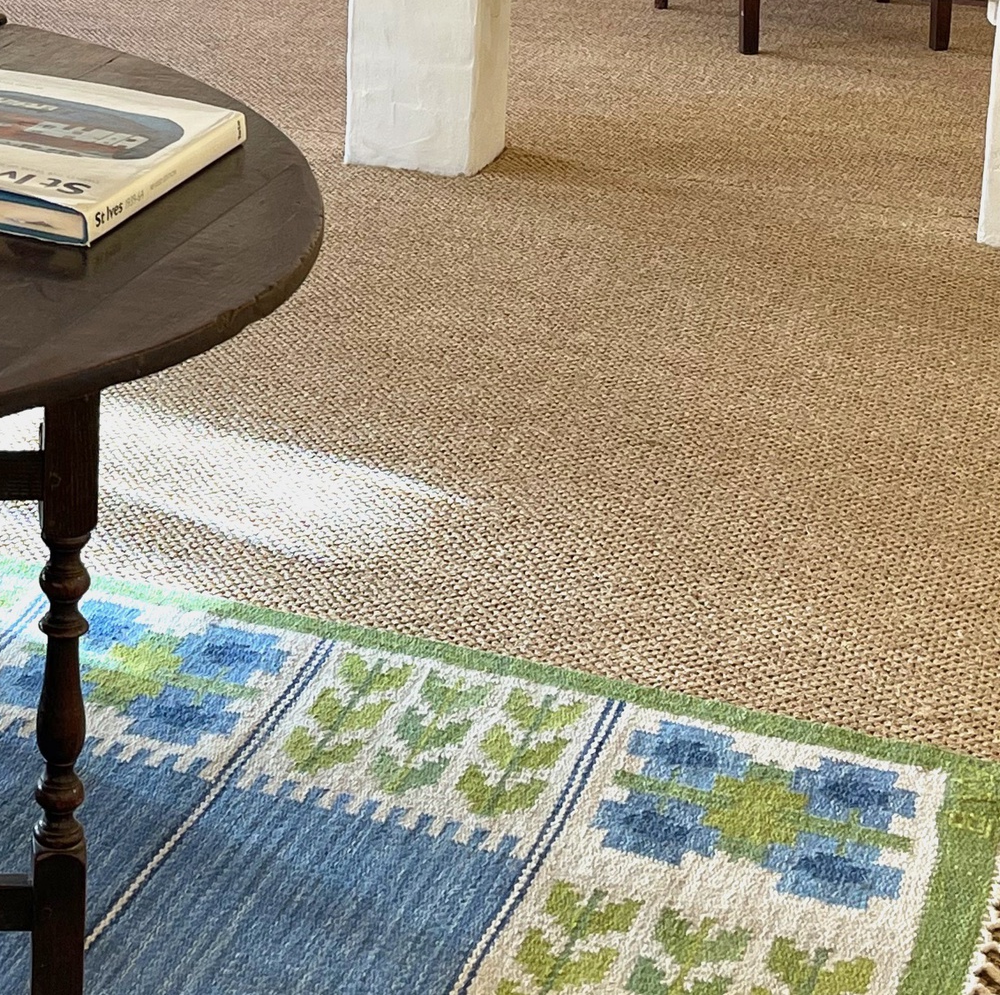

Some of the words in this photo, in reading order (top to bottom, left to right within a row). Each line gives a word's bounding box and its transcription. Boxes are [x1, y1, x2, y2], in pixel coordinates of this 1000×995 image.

[40, 178, 91, 195] St
[95, 211, 105, 227] St
[106, 202, 123, 221] Ives
